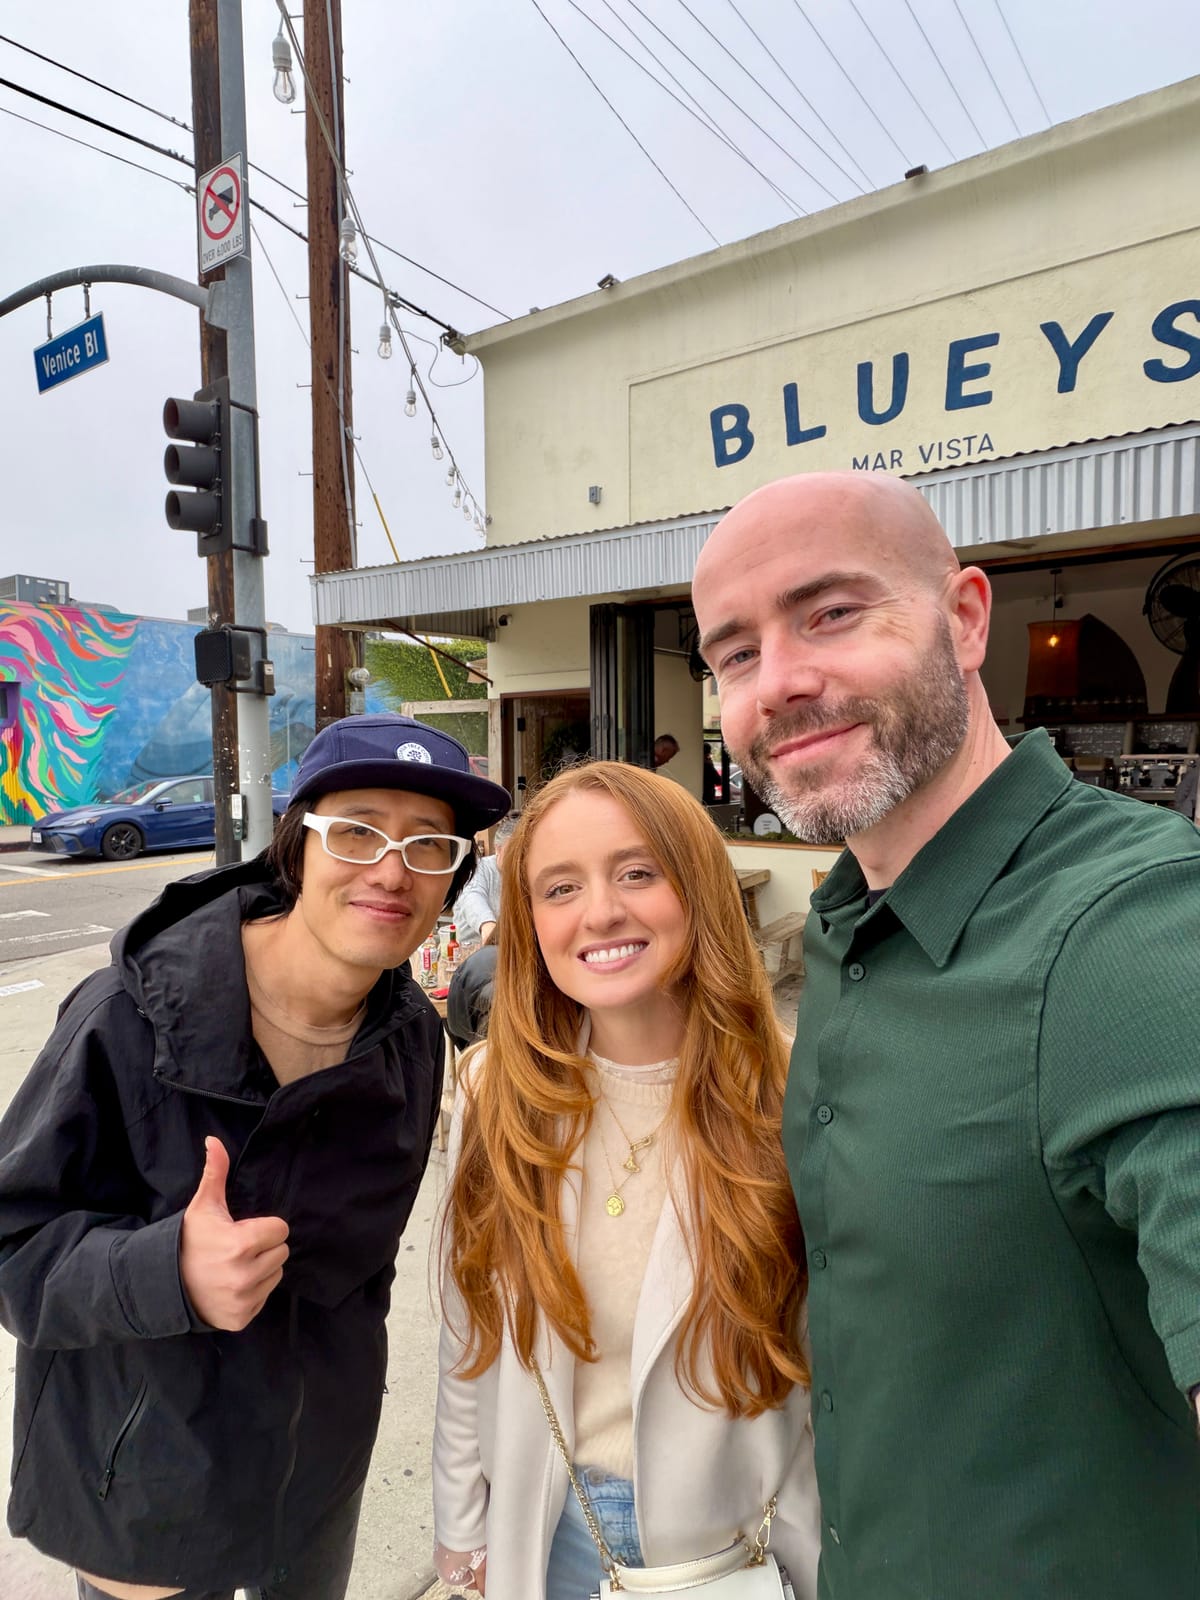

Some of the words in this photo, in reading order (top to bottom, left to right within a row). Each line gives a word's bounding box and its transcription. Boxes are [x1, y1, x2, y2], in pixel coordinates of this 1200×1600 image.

[203, 249, 215, 264] OVER
[232, 234, 242, 248] LBS
[42, 344, 80, 378] Venice
[84, 329, 99, 358] Bl
[709, 298, 1200, 468] BLUEYS
[852, 449, 903, 471] MAR
[918, 433, 994, 464] VISTA
